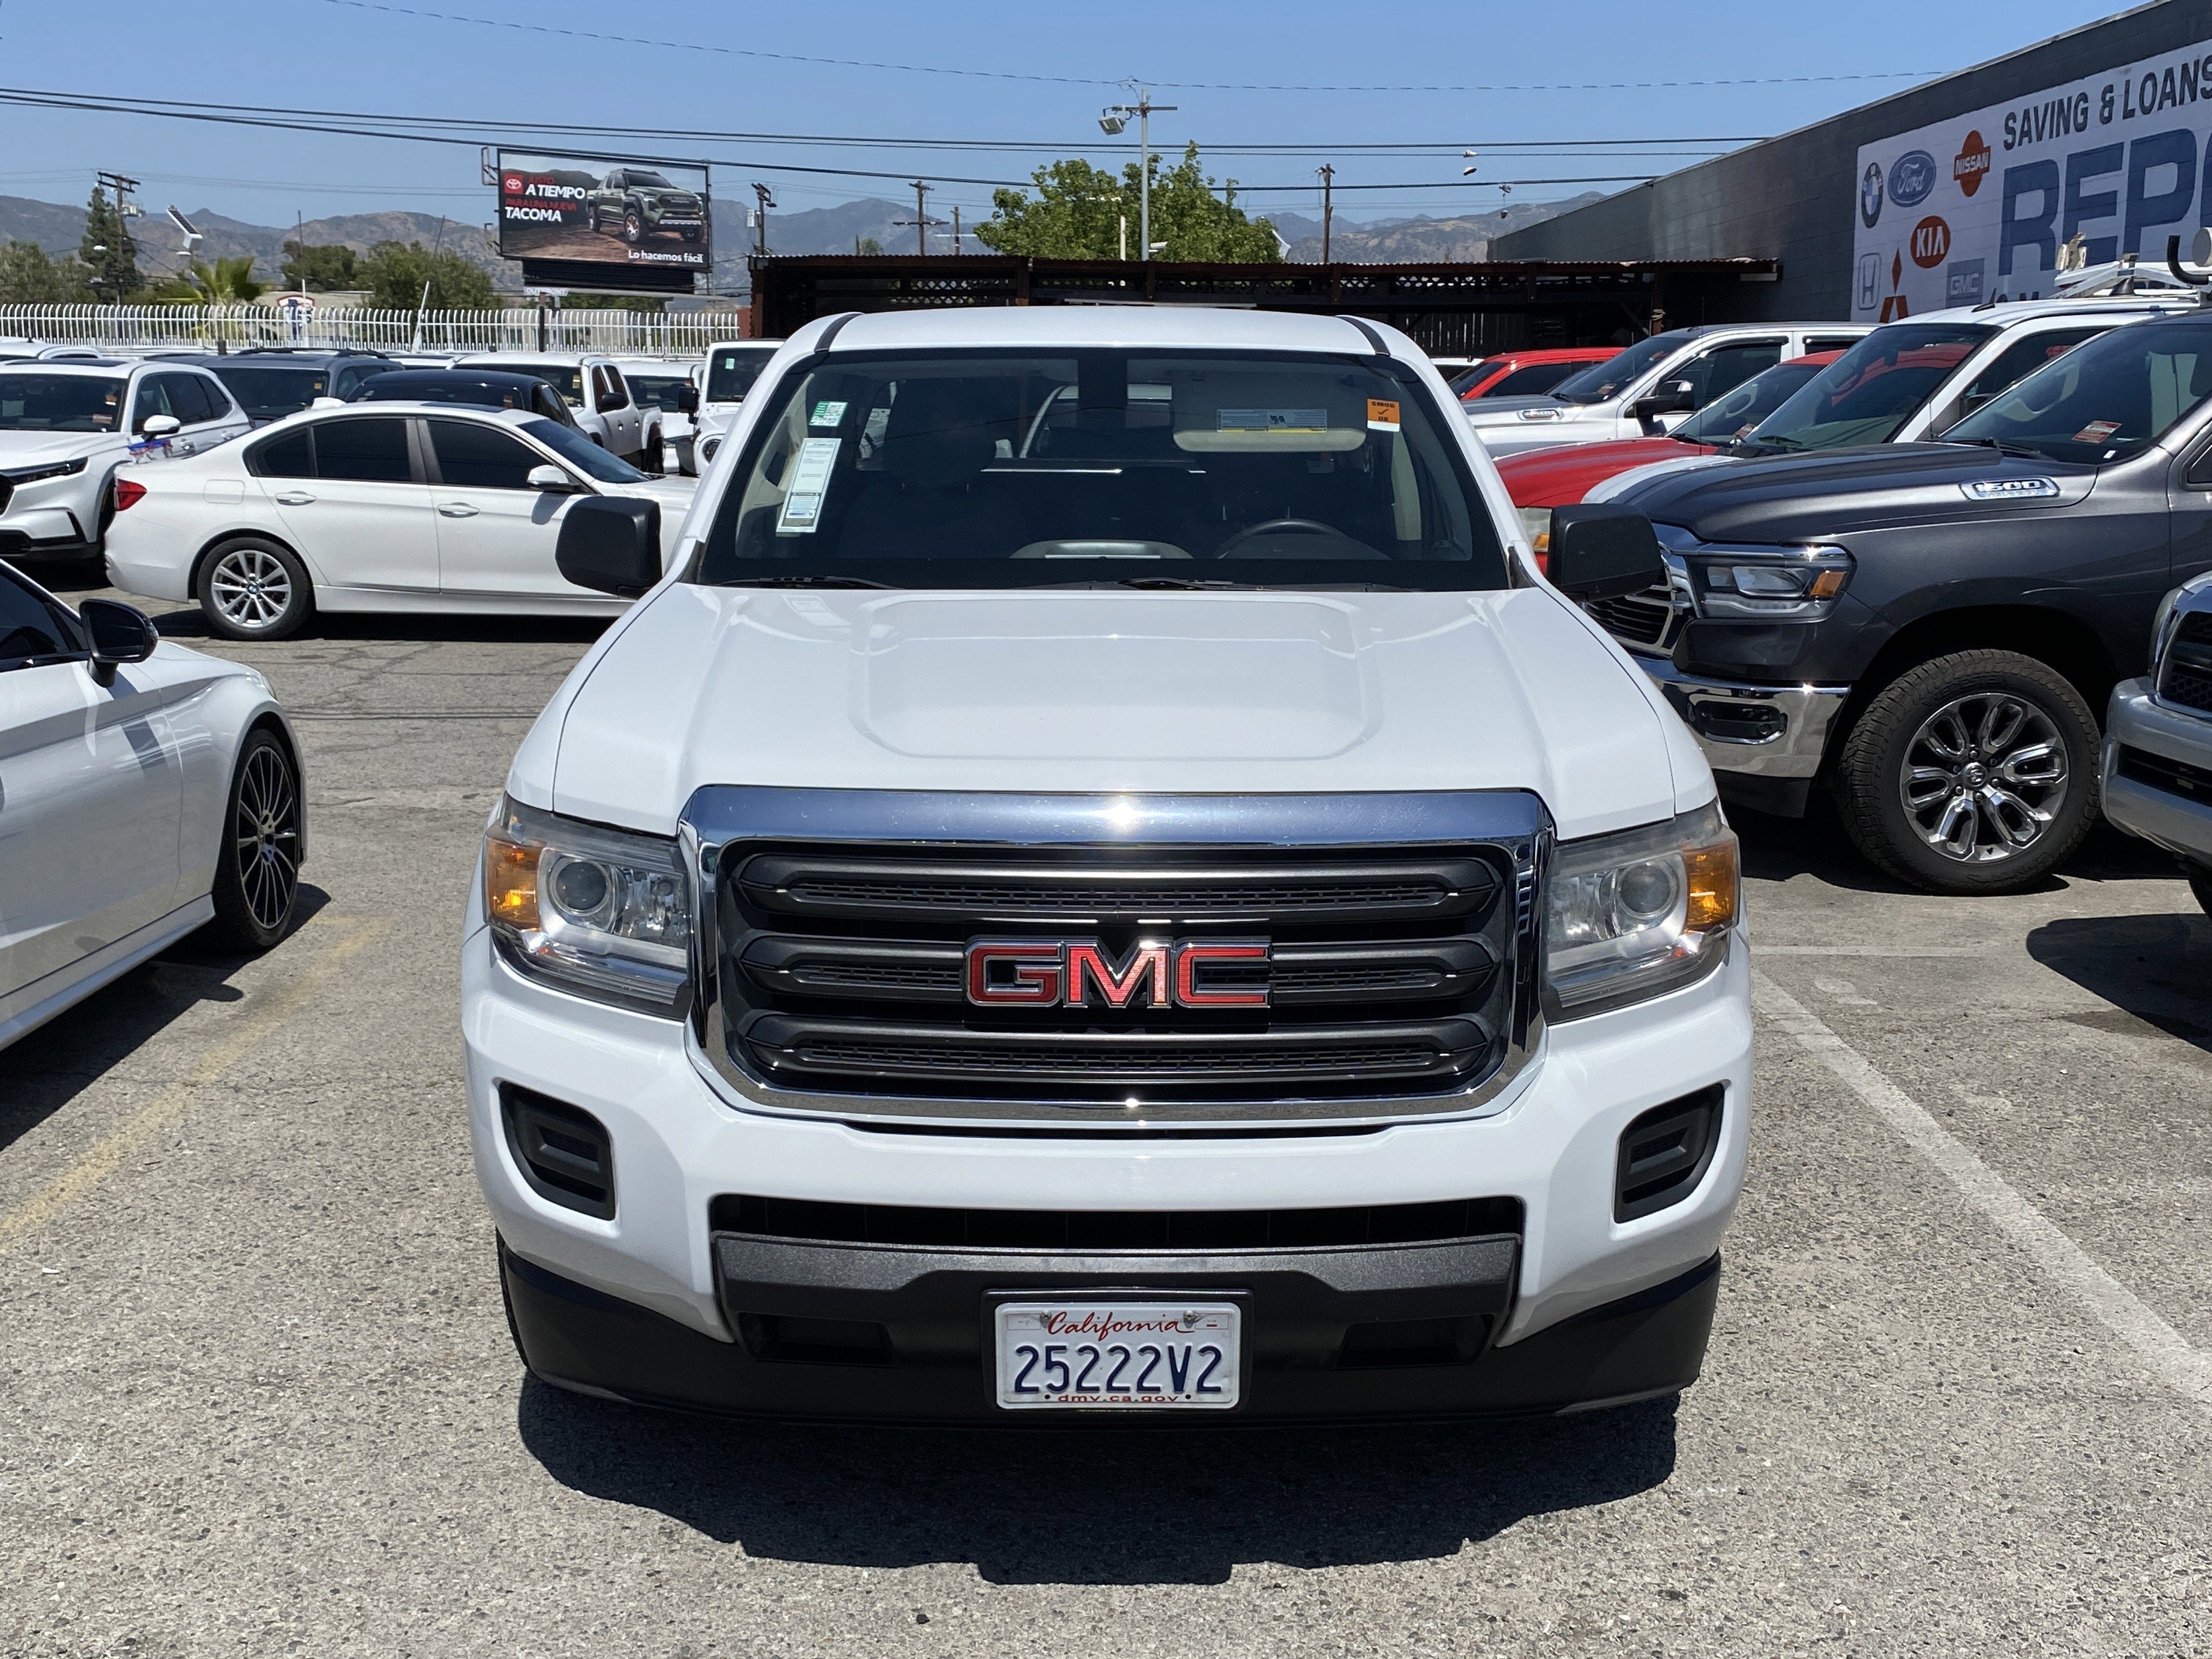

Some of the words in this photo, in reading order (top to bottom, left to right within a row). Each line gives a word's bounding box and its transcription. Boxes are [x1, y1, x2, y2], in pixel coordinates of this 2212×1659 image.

[2004, 92, 2089, 151] SAVING
[2100, 84, 2114, 125] &
[2123, 55, 2212, 120] LOANS
[1955, 152, 1990, 176] NISSAN
[525, 184, 537, 196] A
[537, 184, 586, 199] TIEMPO
[1897, 163, 1927, 195] Ford
[505, 206, 562, 222] TACOMA
[1999, 128, 2212, 276] REP
[1916, 225, 1945, 258] KIA
[628, 249, 640, 258] Lo
[641, 250, 682, 261] hacemos
[684, 252, 703, 263] fácil
[1950, 273, 1979, 295] GMC
[1976, 481, 2041, 492] 1500
[966, 935, 1271, 1008] GMC
[1047, 1311, 1195, 1341] California
[1014, 1345, 1222, 1393] 25222V2
[1058, 1393, 1178, 1403] dmv.ca.gov
